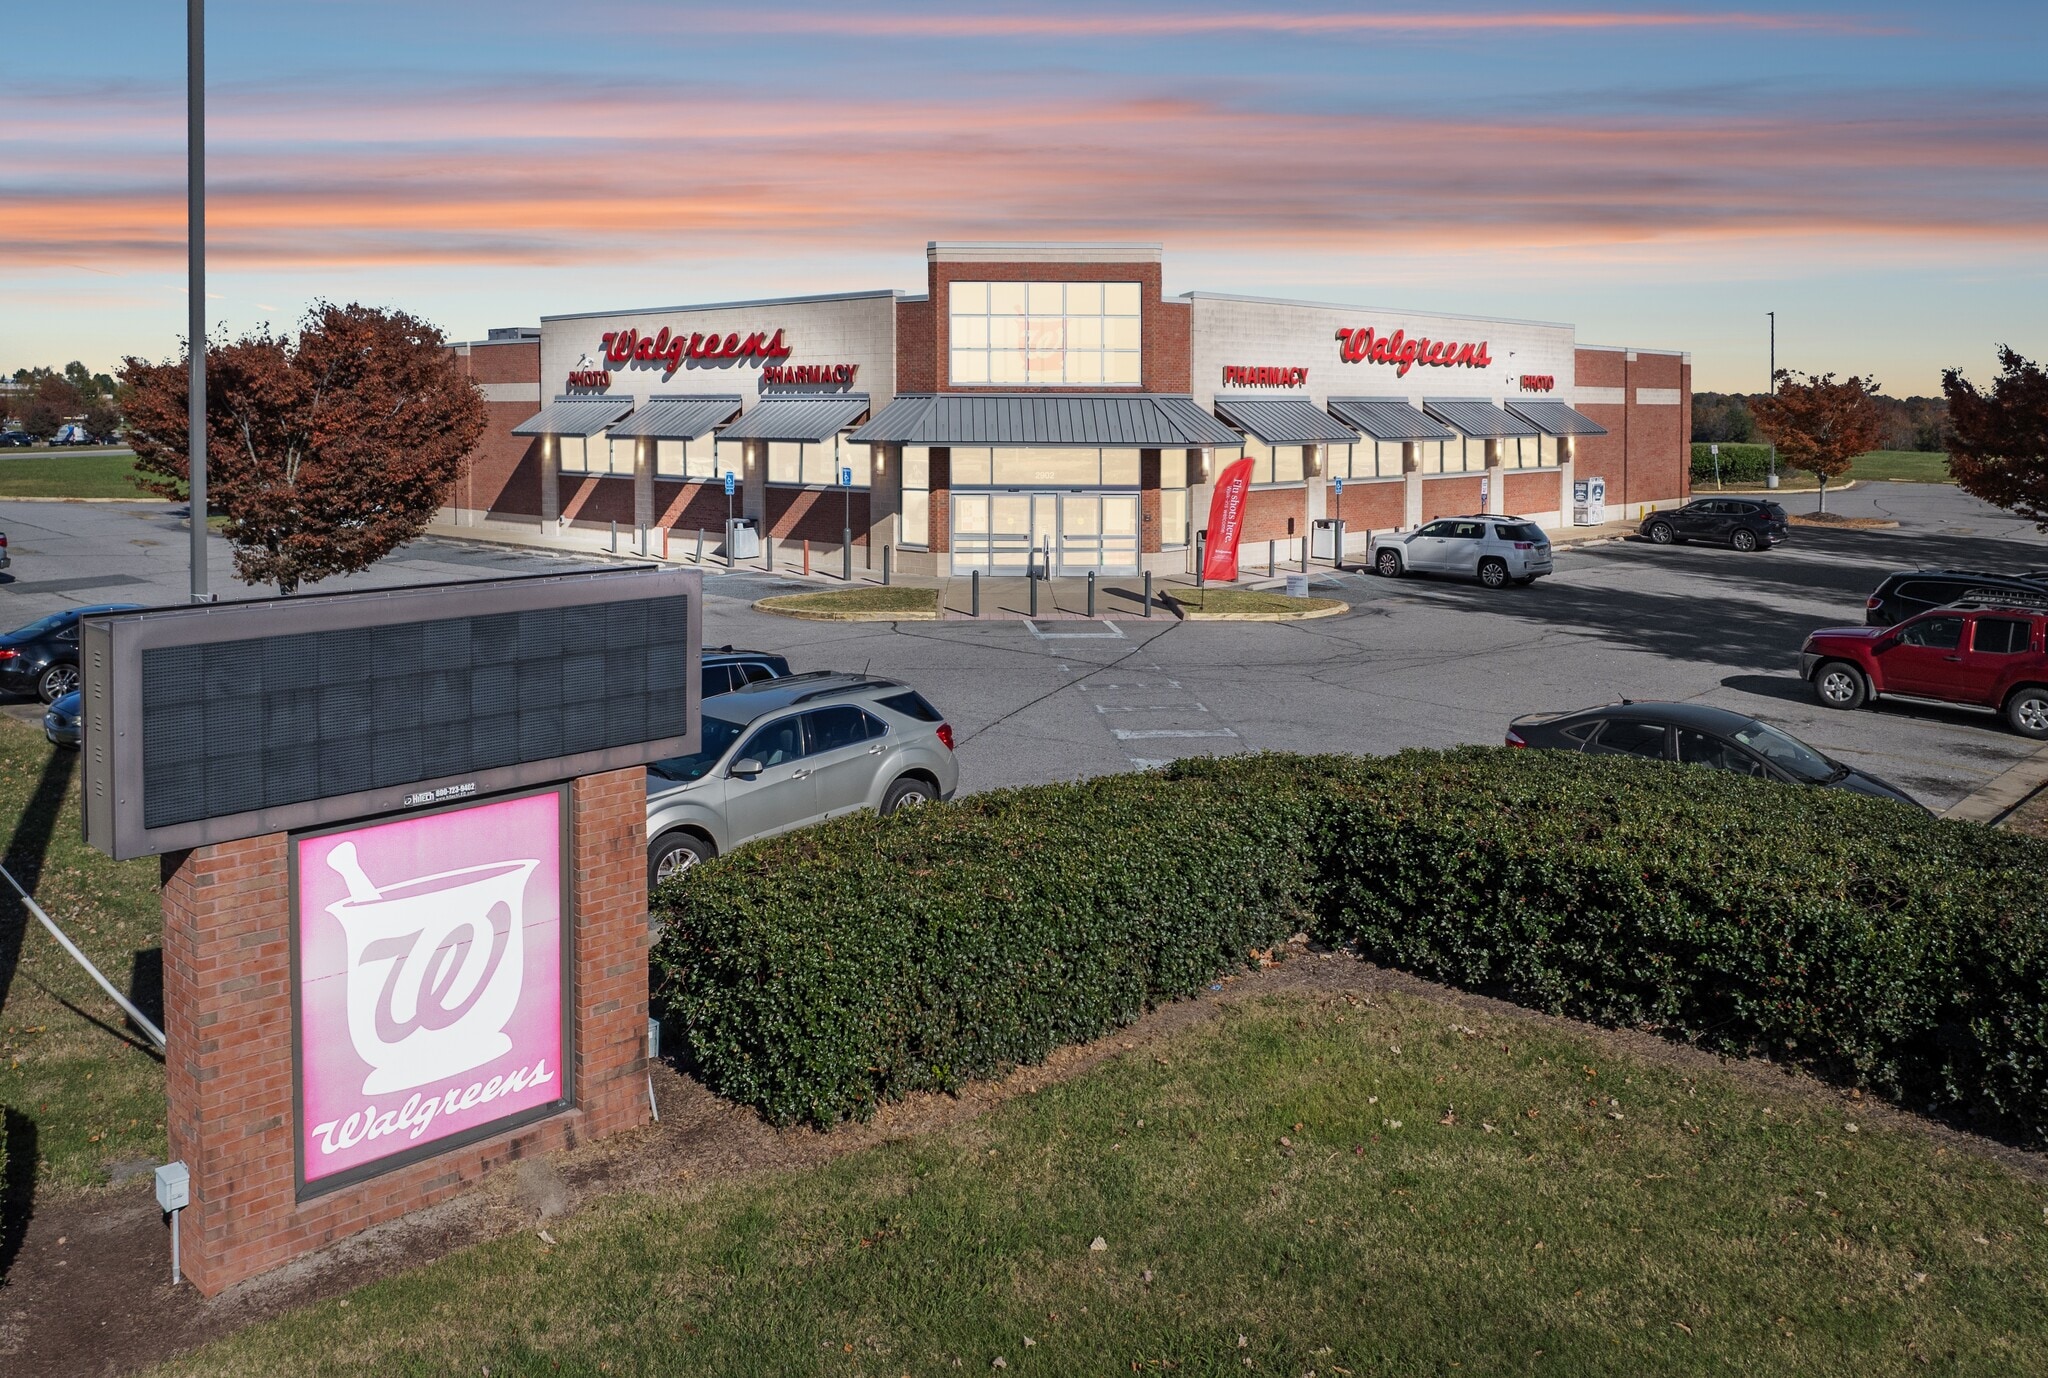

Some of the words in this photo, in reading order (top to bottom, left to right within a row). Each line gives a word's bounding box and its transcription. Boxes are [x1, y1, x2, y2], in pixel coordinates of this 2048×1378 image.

[602, 326, 791, 373] Walgreens
[1335, 326, 1492, 379] Walgreens
[568, 370, 610, 387] PHOTO
[763, 364, 859, 384] PHARMACY
[1224, 365, 1309, 387] PHARMACY
[1522, 375, 1555, 391] PHOTO
[1035, 471, 1055, 480] 2902
[1233, 479, 1242, 493] Flu
[1228, 494, 1241, 520] shots
[1225, 521, 1237, 543] here.
[436, 783, 475, 797] 800-723-9402
[358, 900, 512, 1044] W
[311, 1058, 555, 1155] Walgreens
